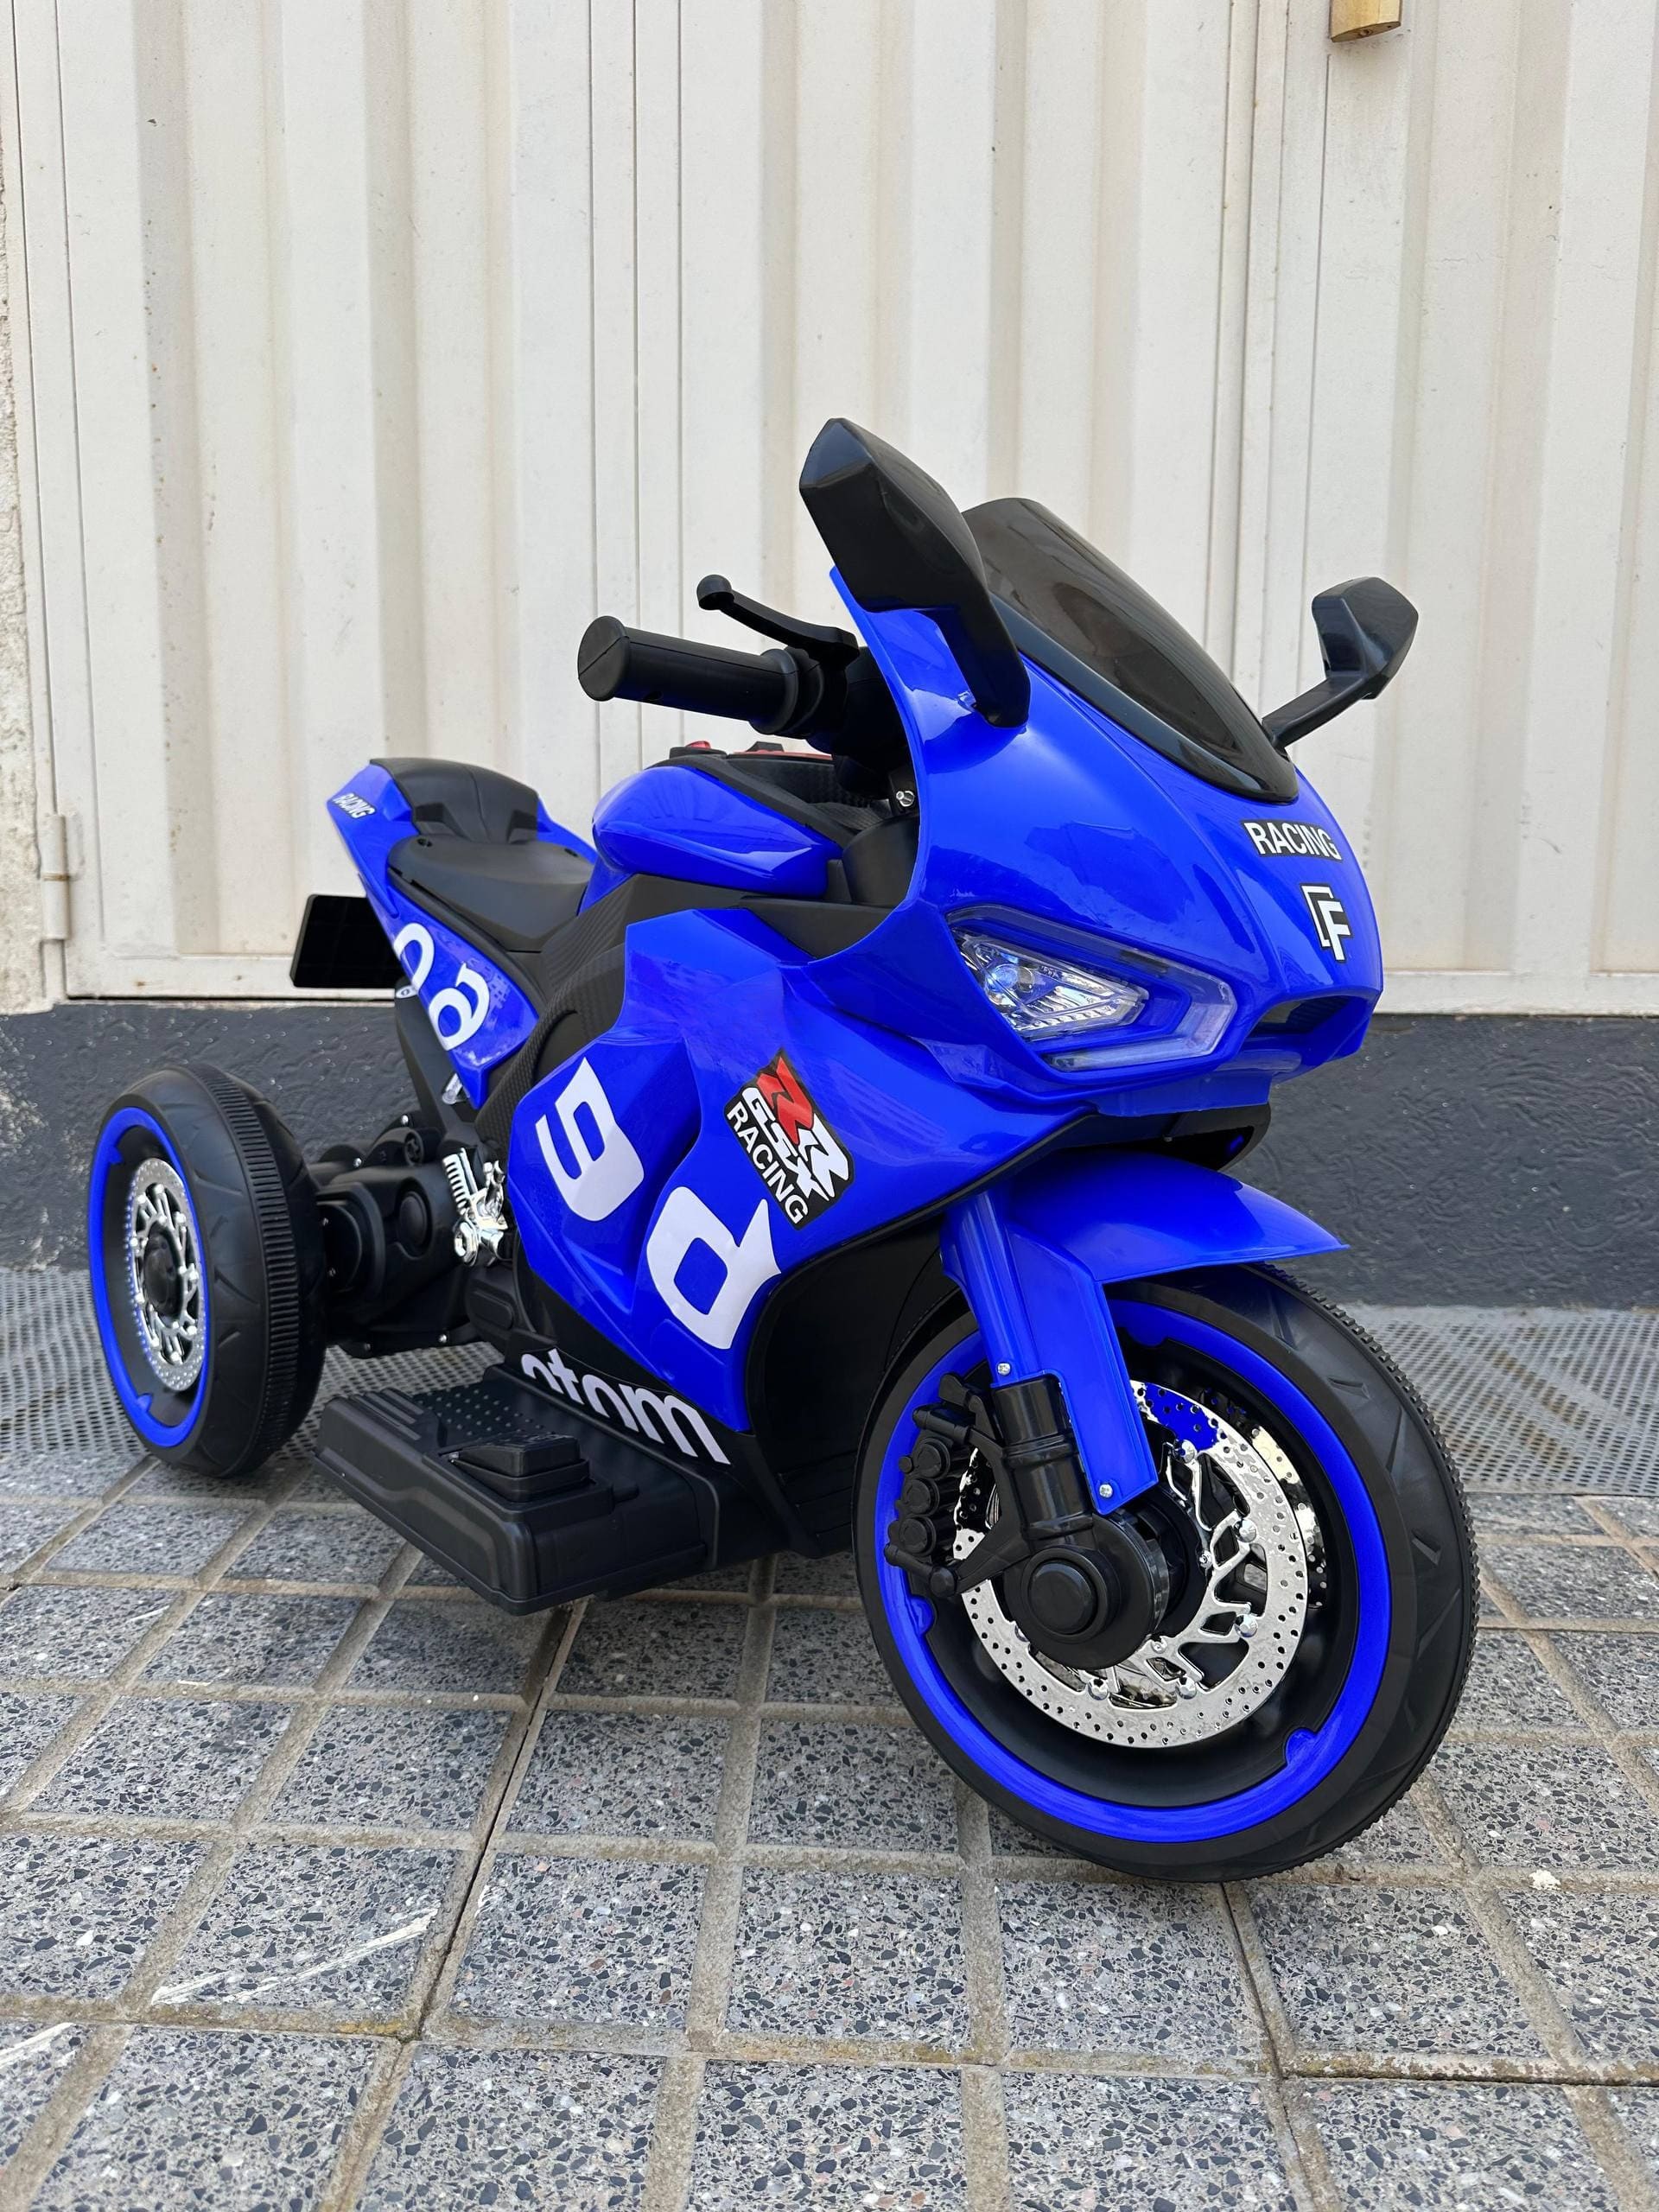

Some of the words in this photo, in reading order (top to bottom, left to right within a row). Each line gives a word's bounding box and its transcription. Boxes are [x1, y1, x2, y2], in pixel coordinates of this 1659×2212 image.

[333, 793, 375, 818] RACING
[1244, 822, 1342, 860] RACING
[727, 1101, 808, 1224] RACING
[741, 1087, 830, 1201] GSX
